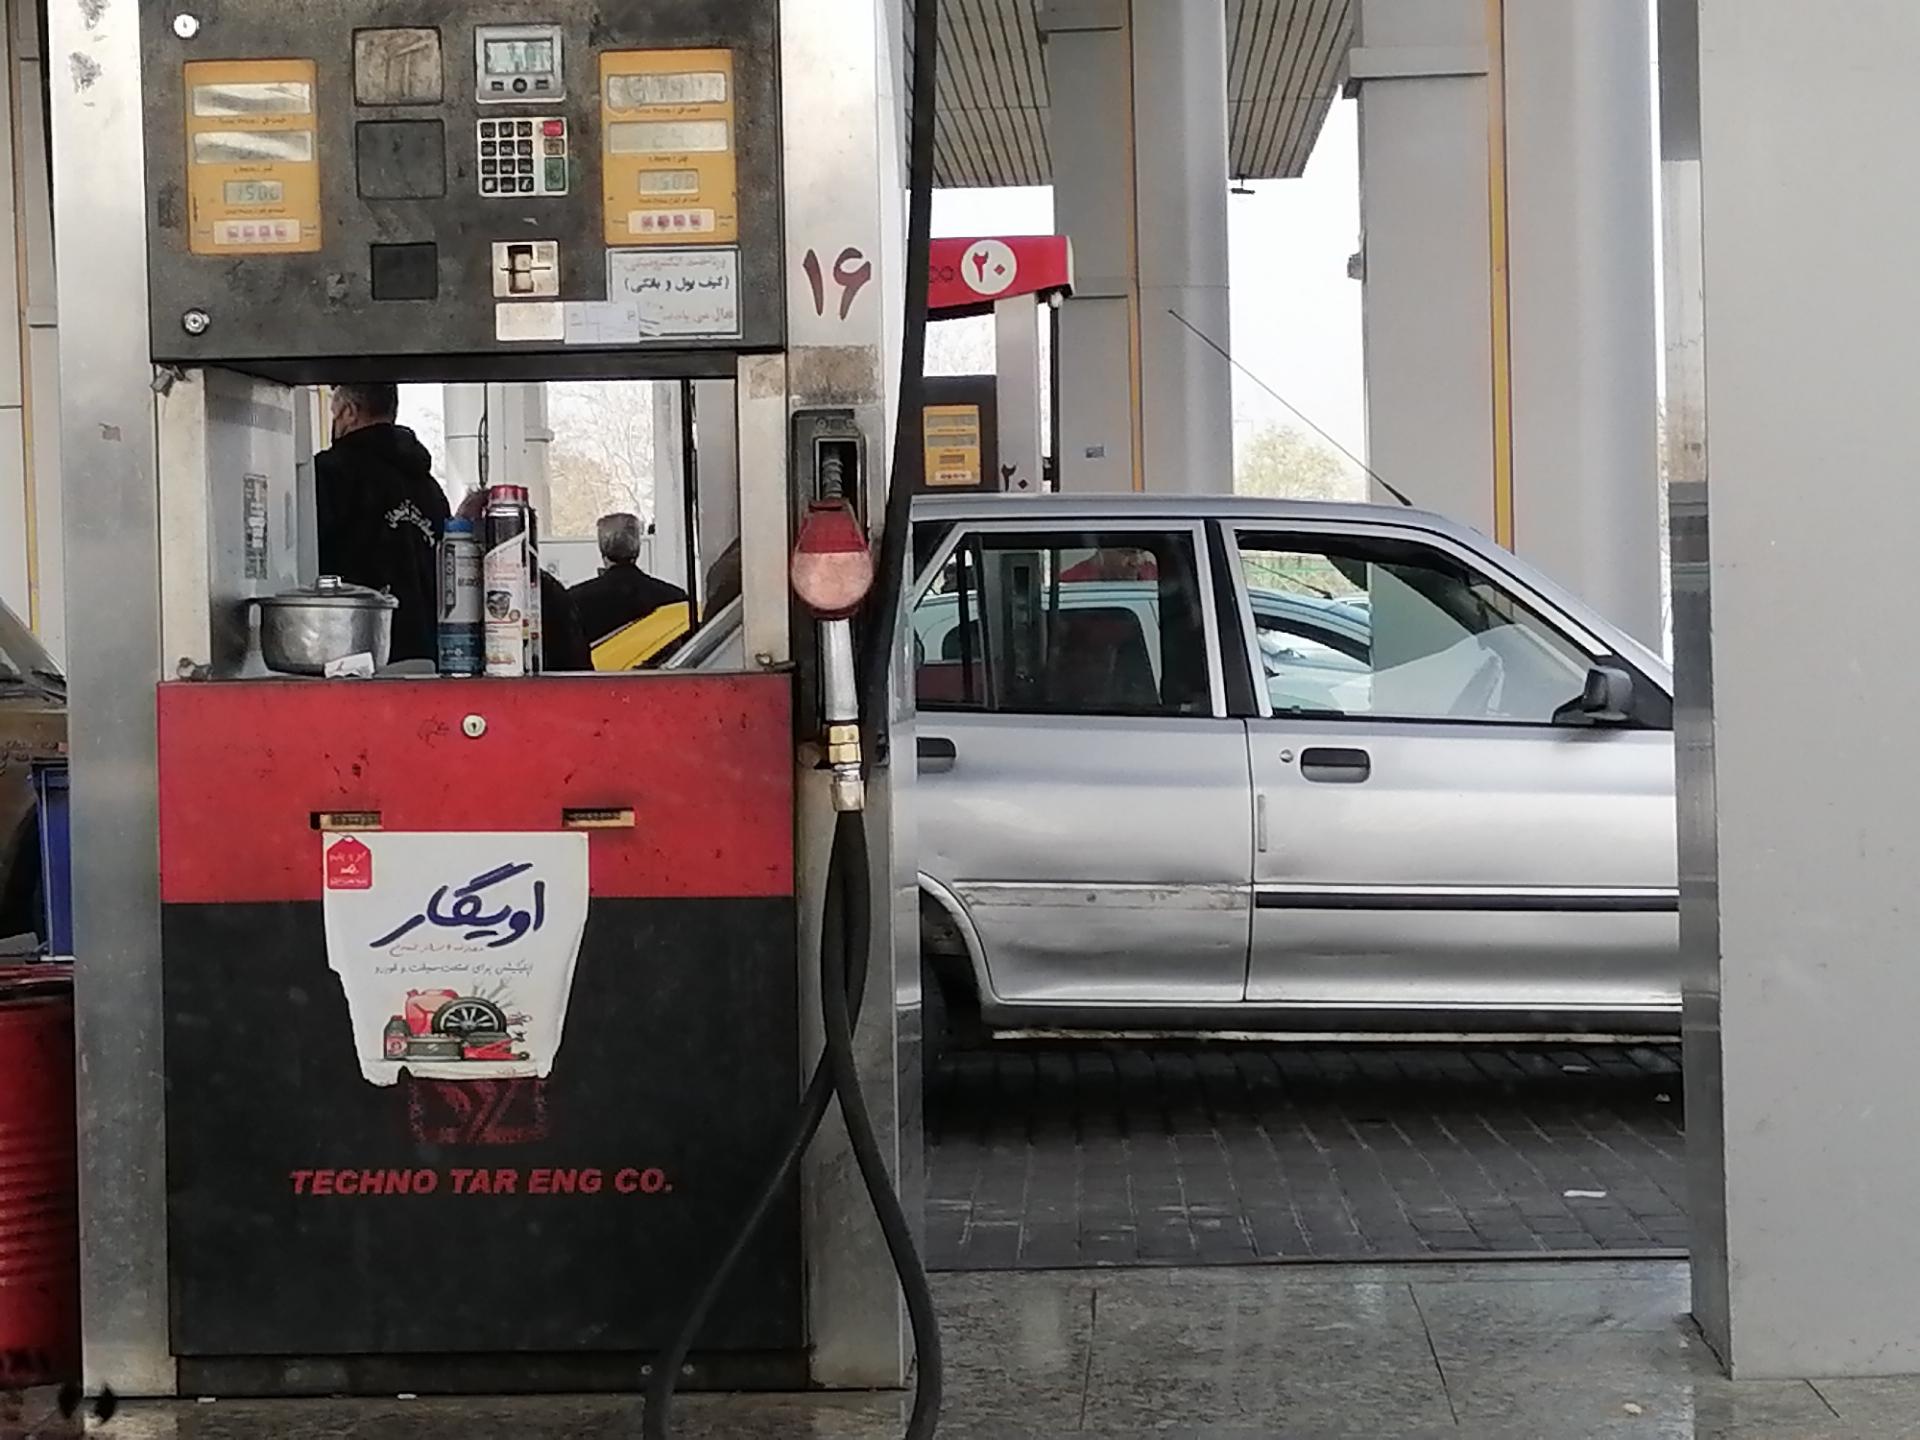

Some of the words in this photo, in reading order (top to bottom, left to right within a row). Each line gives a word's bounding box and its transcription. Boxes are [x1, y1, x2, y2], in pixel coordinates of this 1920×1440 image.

[972, 250, 1006, 283] ۲۰
[802, 247, 872, 320] ۱۶
[1001, 463, 1029, 492] ۲۰
[289, 1169, 438, 1194] TECHNO
[450, 1168, 518, 1193] TAR
[528, 1168, 603, 1193] ENG
[614, 1167, 673, 1193] CO.
